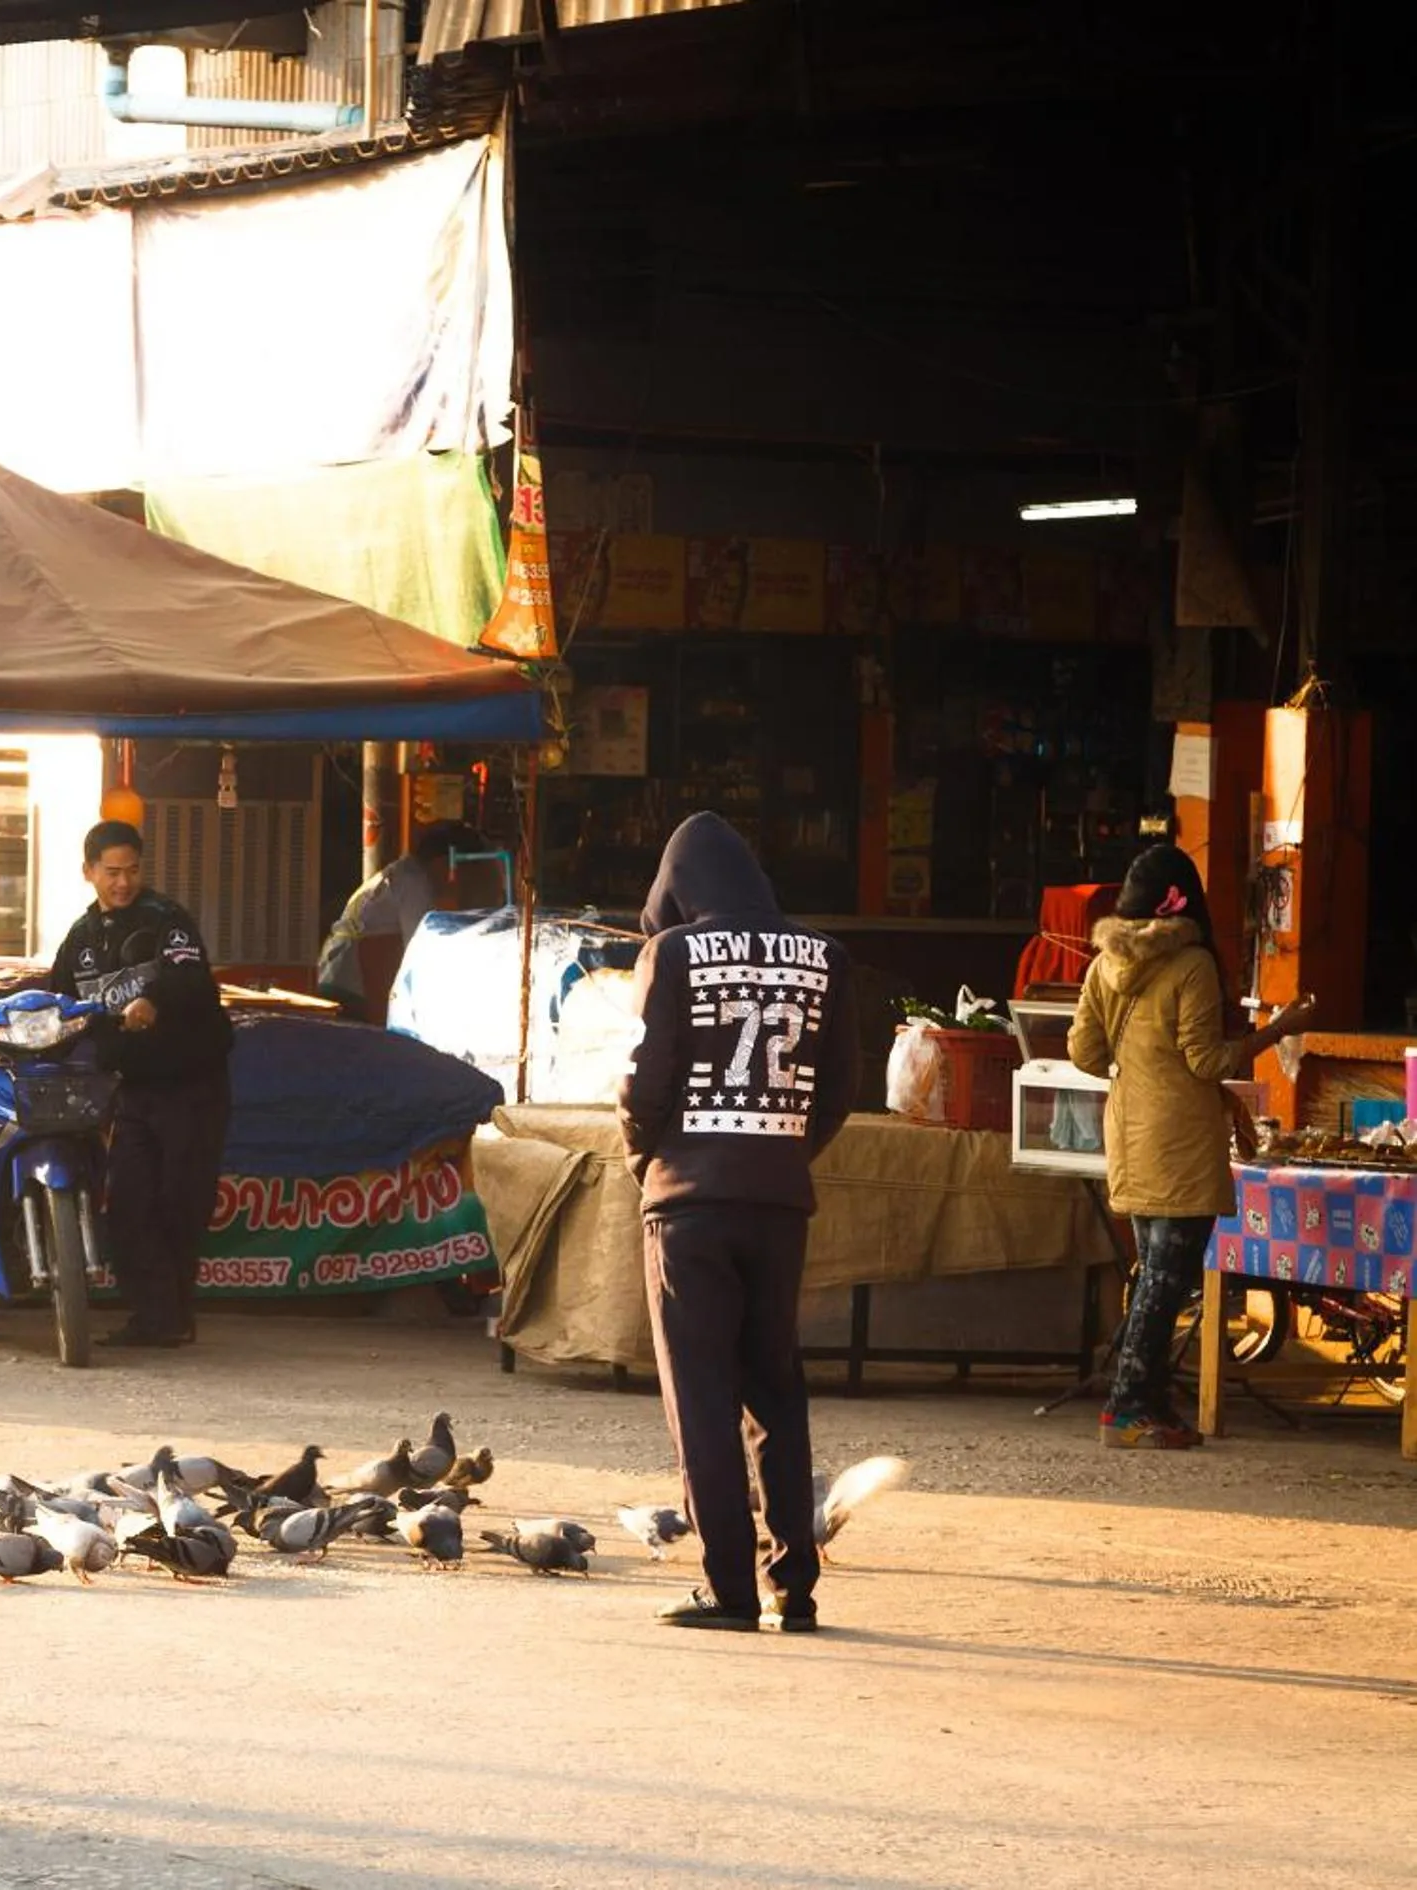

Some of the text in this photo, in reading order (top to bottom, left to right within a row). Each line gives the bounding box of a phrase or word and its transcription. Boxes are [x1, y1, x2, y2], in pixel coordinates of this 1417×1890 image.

[685, 931, 829, 970] NEW YORK
[719, 999, 805, 1089] 72
